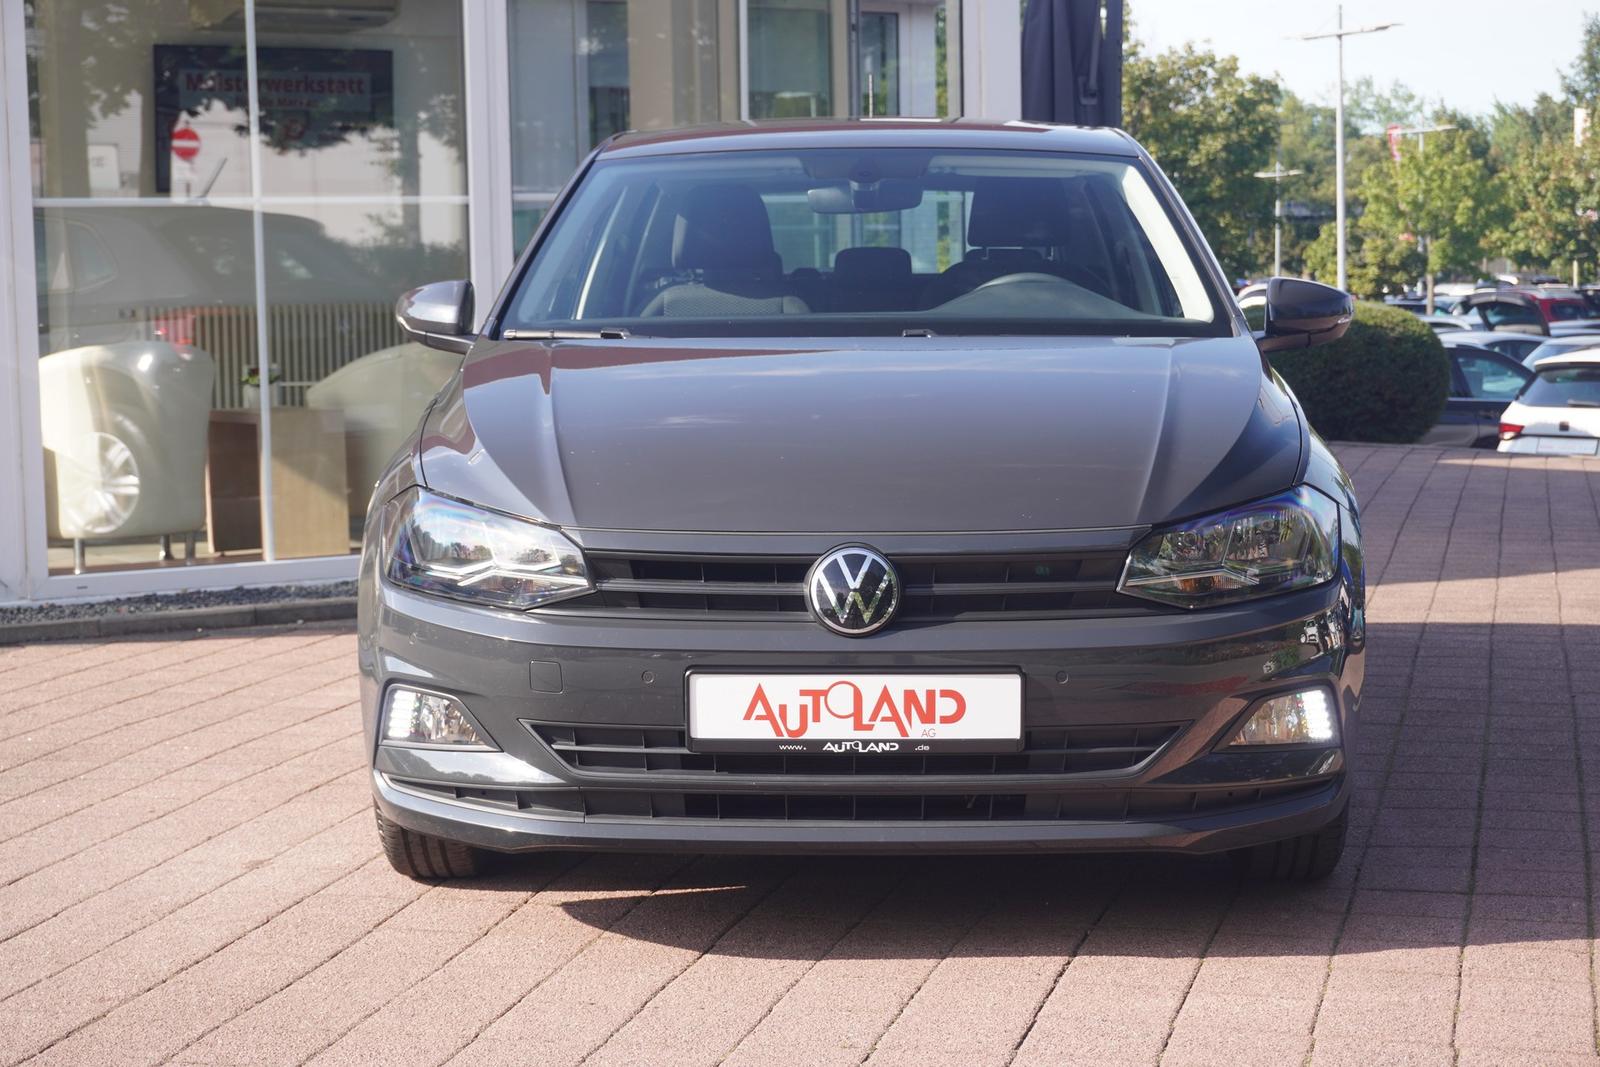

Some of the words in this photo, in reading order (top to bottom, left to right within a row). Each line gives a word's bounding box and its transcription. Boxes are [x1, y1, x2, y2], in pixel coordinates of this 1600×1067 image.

[814, 551, 896, 628] VW
[921, 728, 937, 738] AG
[914, 743, 930, 751] .de
